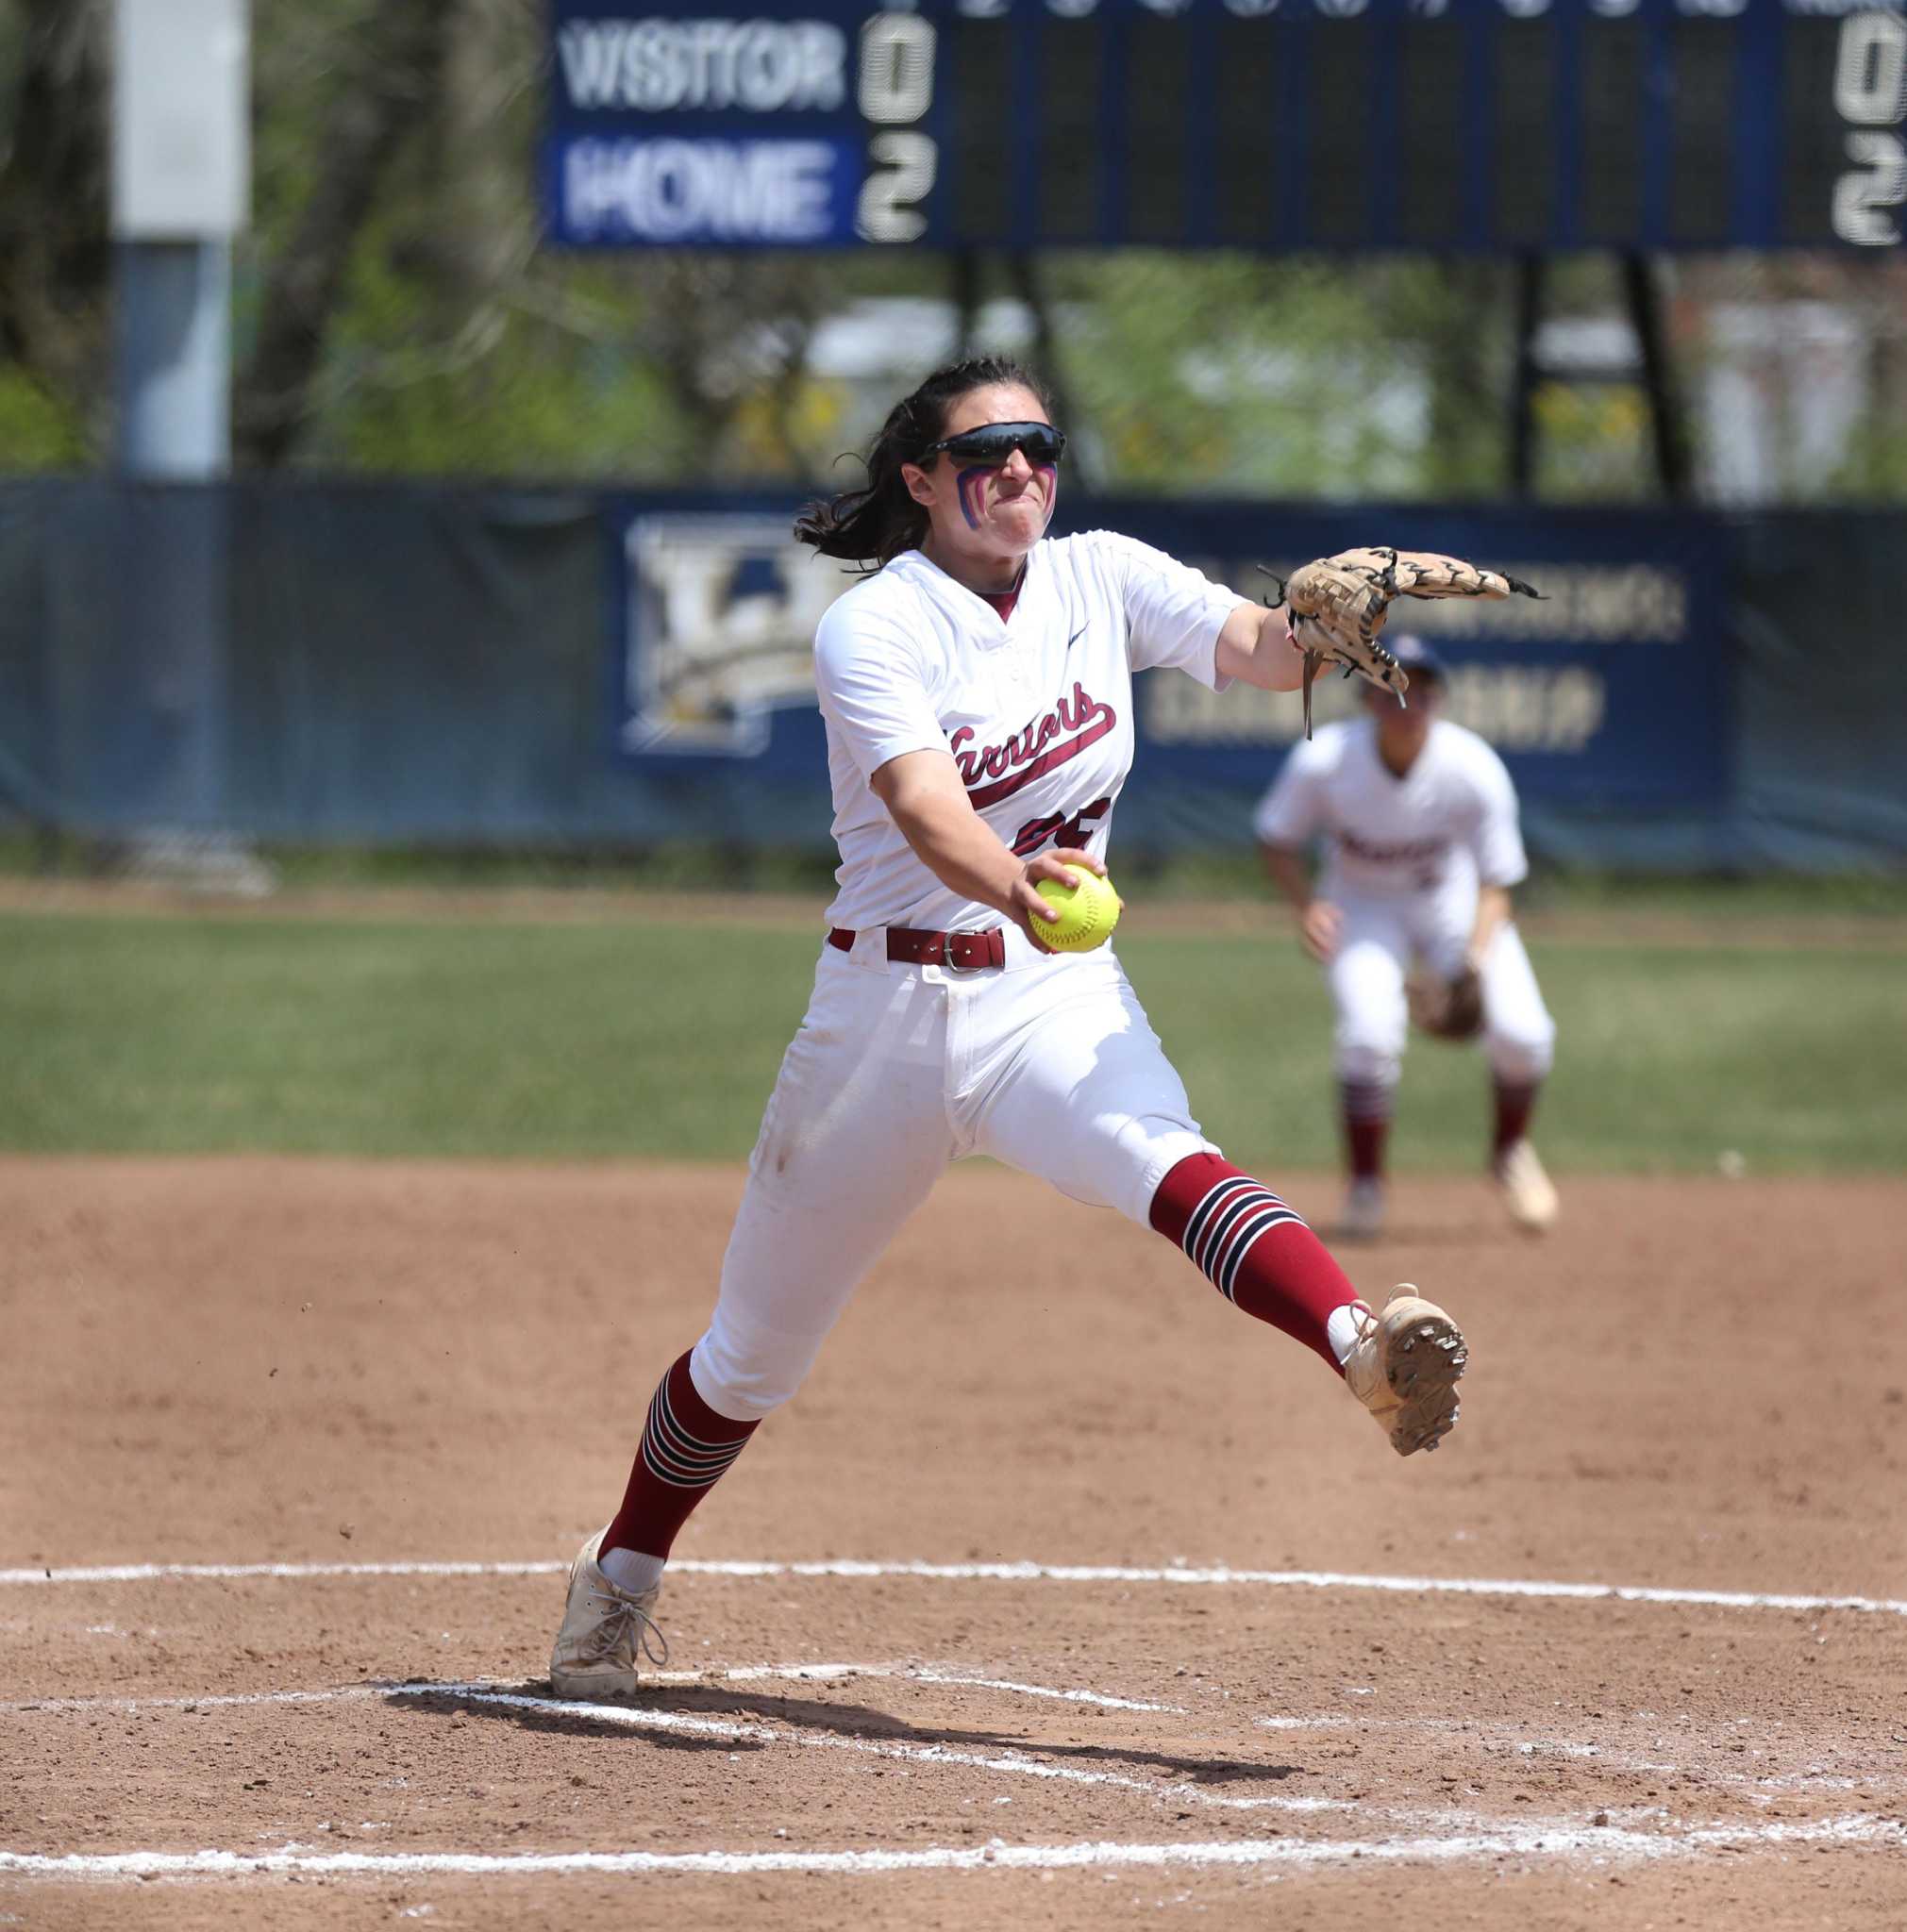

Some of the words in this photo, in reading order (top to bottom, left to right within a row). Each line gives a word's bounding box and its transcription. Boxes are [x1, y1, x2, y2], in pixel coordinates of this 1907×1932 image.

[860, 11, 937, 123] 0
[1834, 9, 1907, 124] 0
[563, 137, 840, 243] HOME
[855, 130, 938, 242] 2
[1832, 130, 1907, 245] 2
